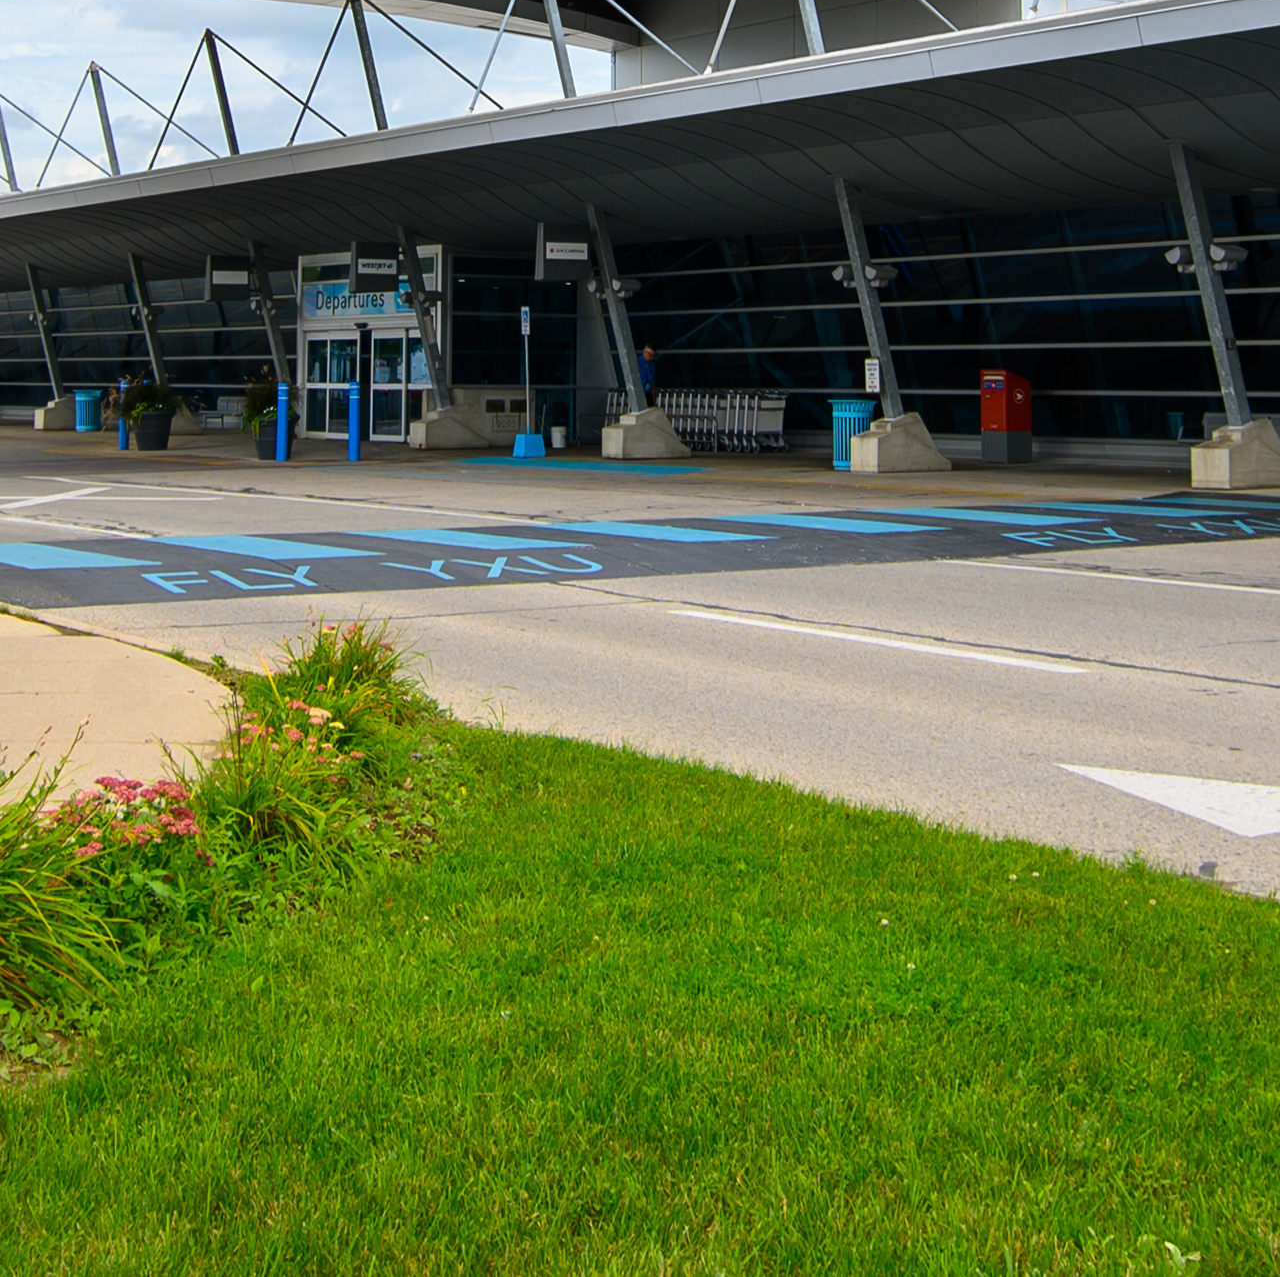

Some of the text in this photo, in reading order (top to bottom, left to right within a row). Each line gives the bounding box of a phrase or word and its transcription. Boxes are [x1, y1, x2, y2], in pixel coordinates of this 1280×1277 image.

[316, 291, 385, 316] Departures
[1000, 527, 1139, 547] FLY
[140, 553, 603, 594] FLY YXU
